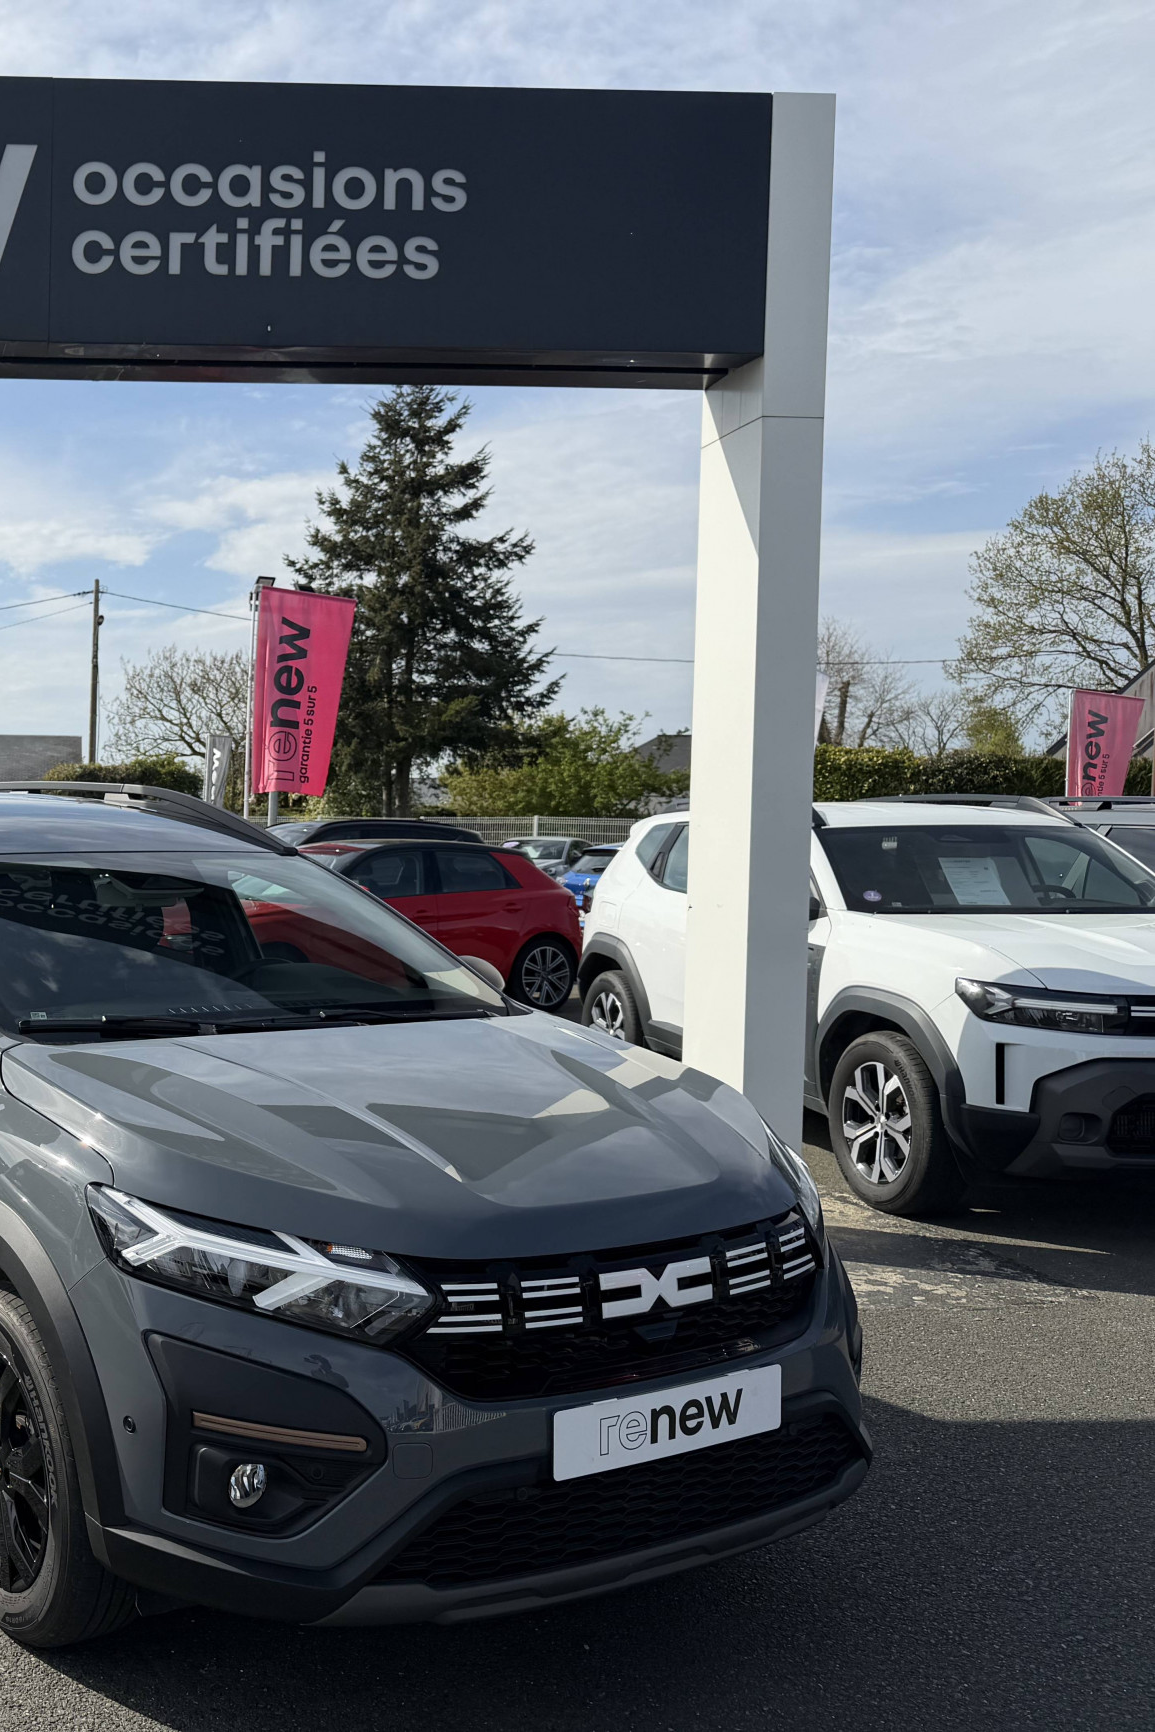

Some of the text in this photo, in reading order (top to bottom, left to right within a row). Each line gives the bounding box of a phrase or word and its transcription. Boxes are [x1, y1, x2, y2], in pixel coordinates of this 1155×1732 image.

[72, 150, 468, 213] occasions
[71, 217, 441, 280] certifiées
[267, 616, 311, 782] renew
[299, 685, 318, 784] garantie 5 sur 5
[598, 1387, 744, 1457] renew
